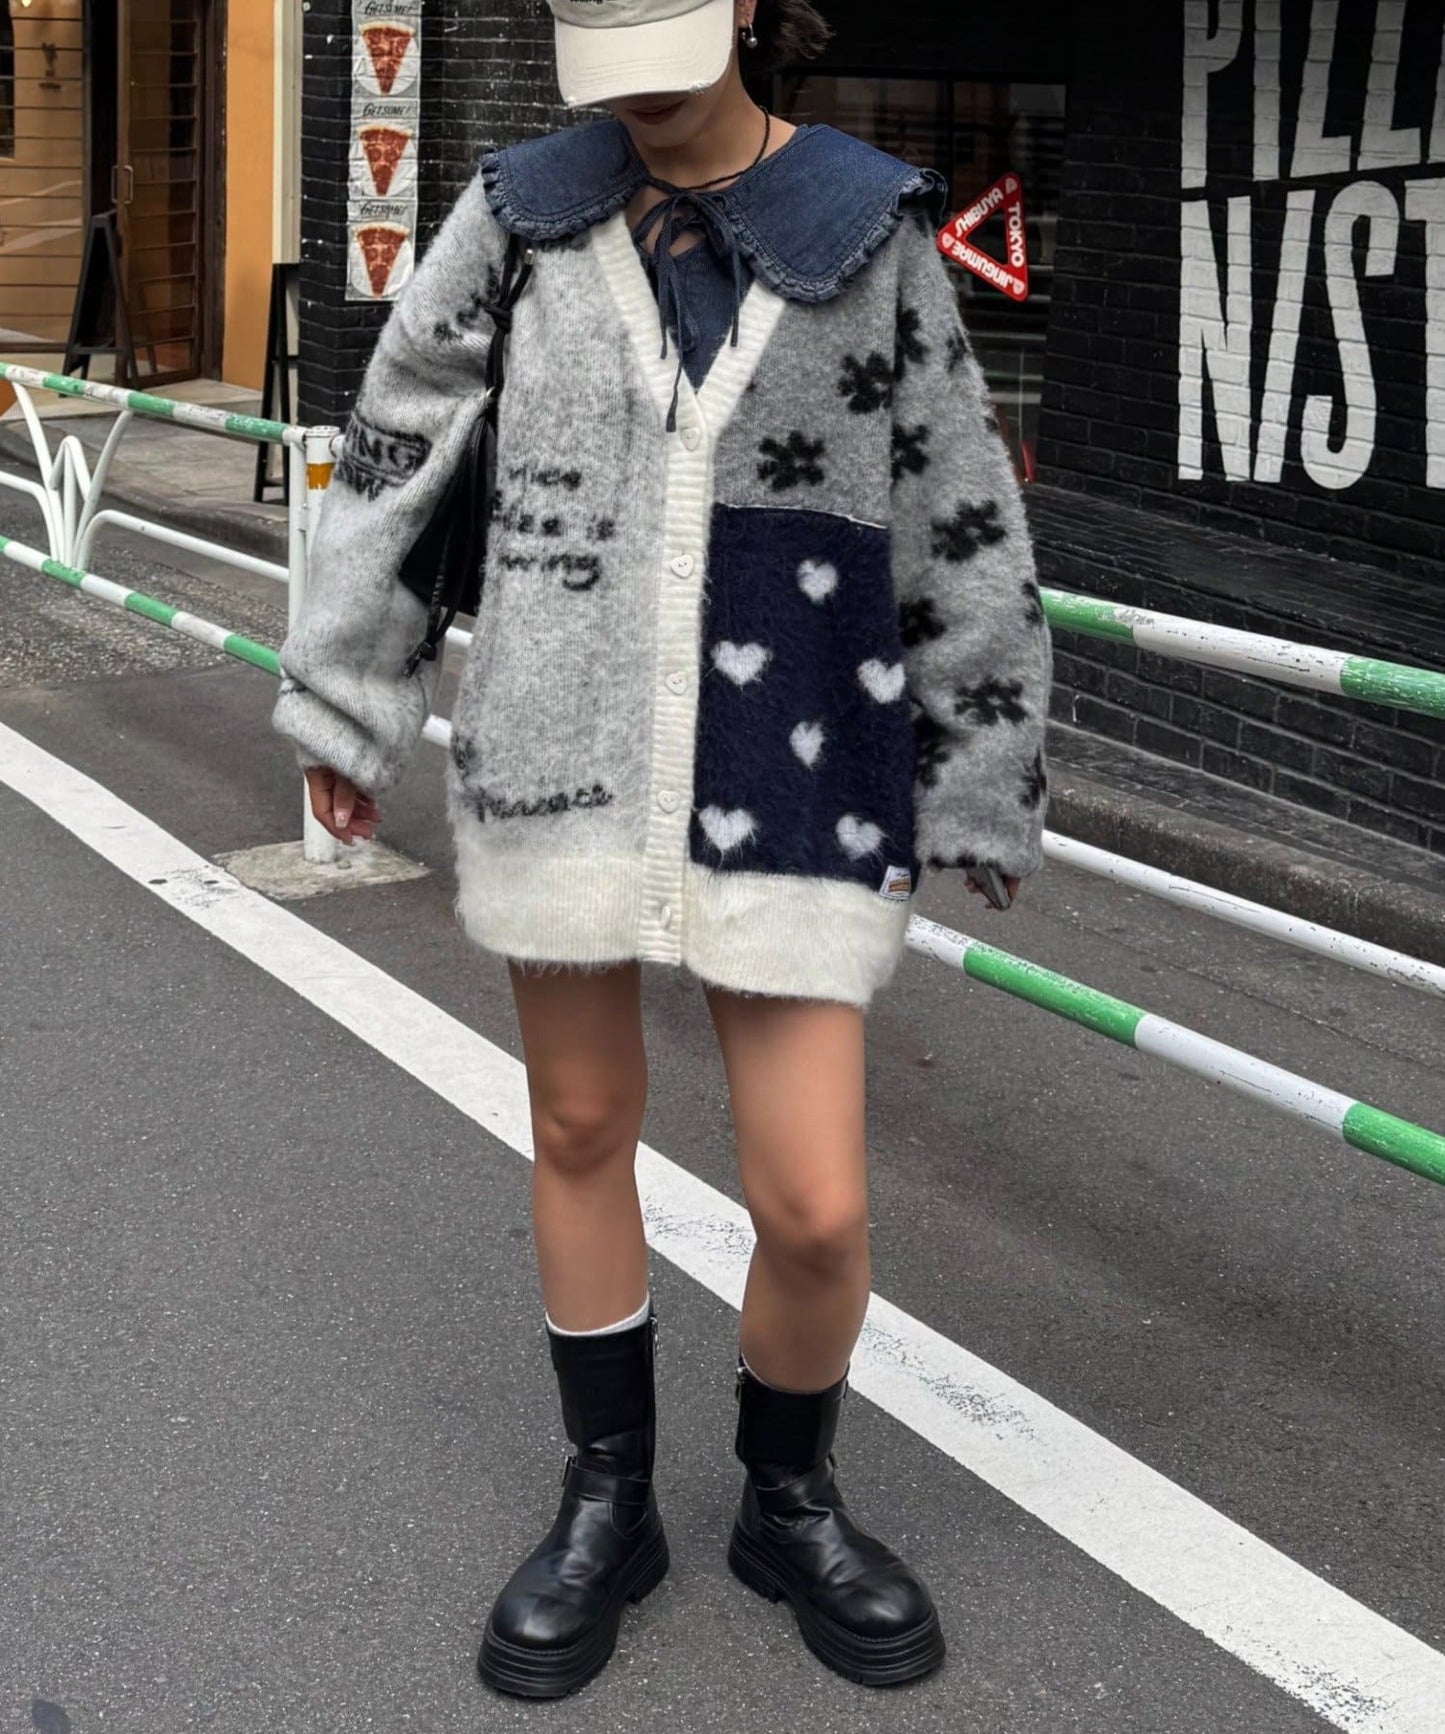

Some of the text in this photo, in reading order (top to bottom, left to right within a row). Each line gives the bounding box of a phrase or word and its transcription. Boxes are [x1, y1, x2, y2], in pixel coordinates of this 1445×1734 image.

[954, 187, 1004, 238] SHIBUYA
[1008, 201, 1025, 268] TOKYO
[951, 240, 1014, 289] JINGUMAE
